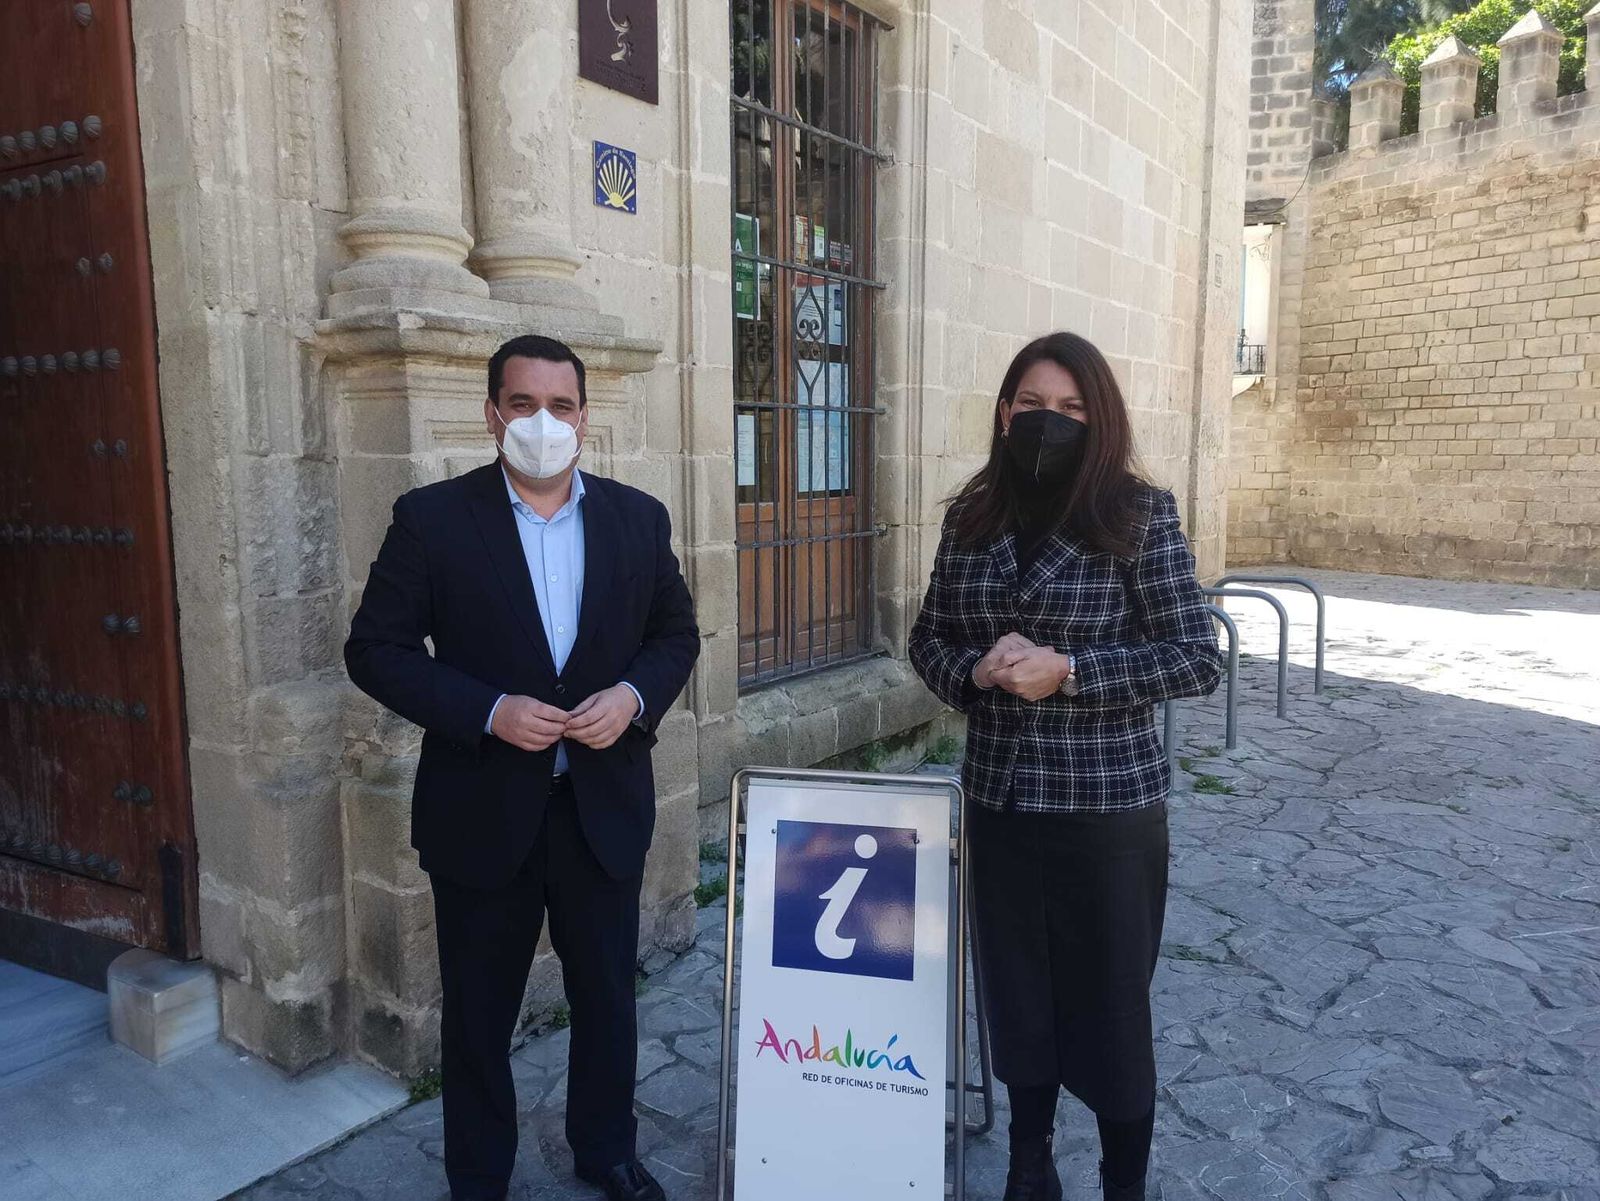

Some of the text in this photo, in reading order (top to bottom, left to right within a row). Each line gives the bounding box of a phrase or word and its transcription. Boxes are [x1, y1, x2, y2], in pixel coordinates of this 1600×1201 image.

[755, 1018, 926, 1081] Andalucía
[802, 1072, 929, 1097] RED DE OFICINAS DE TURISMO
